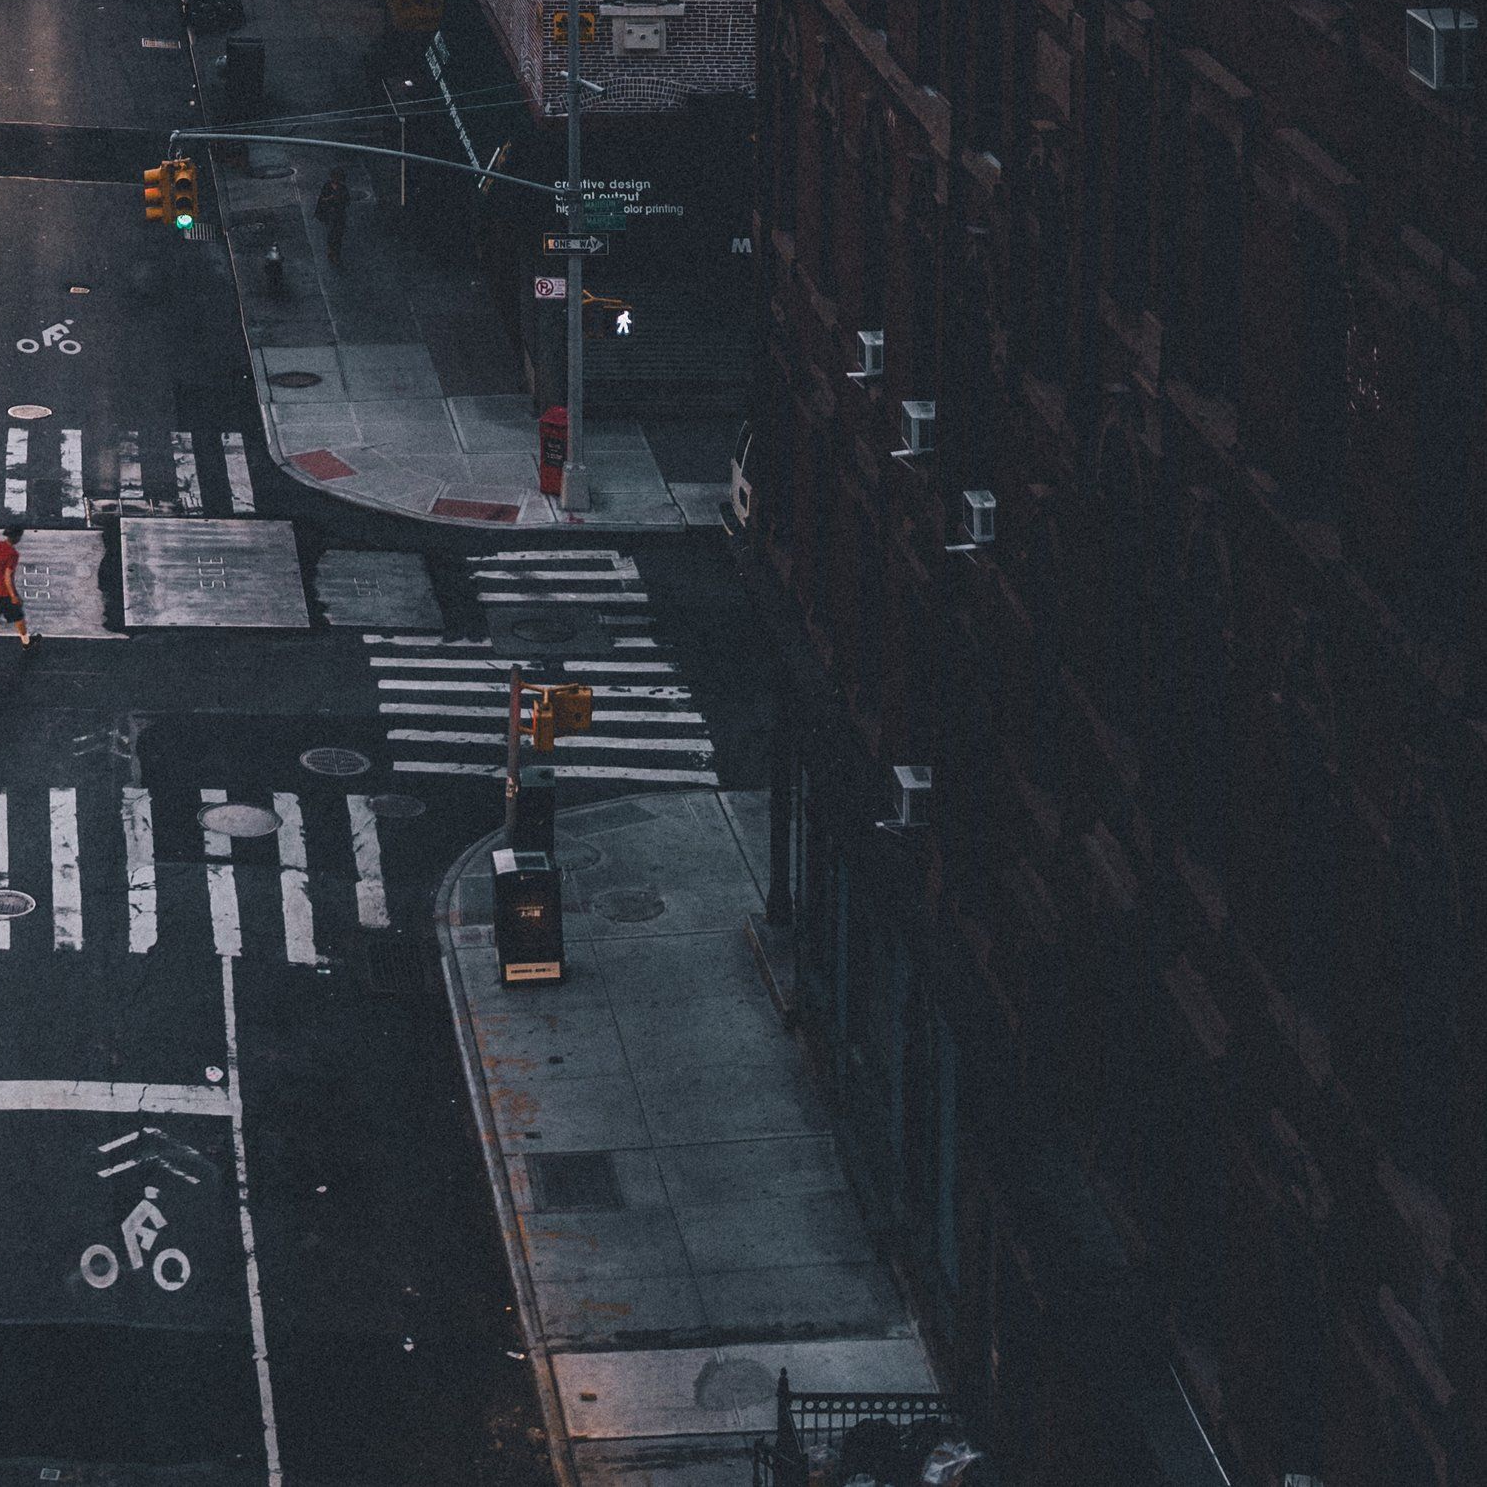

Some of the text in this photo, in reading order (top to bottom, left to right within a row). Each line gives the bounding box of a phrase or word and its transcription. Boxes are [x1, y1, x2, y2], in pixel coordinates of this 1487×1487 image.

[554, 179, 651, 192] crtive design
[623, 203, 643, 214] olor
[645, 204, 684, 216] printing
[553, 239, 599, 249] ONE WAY
